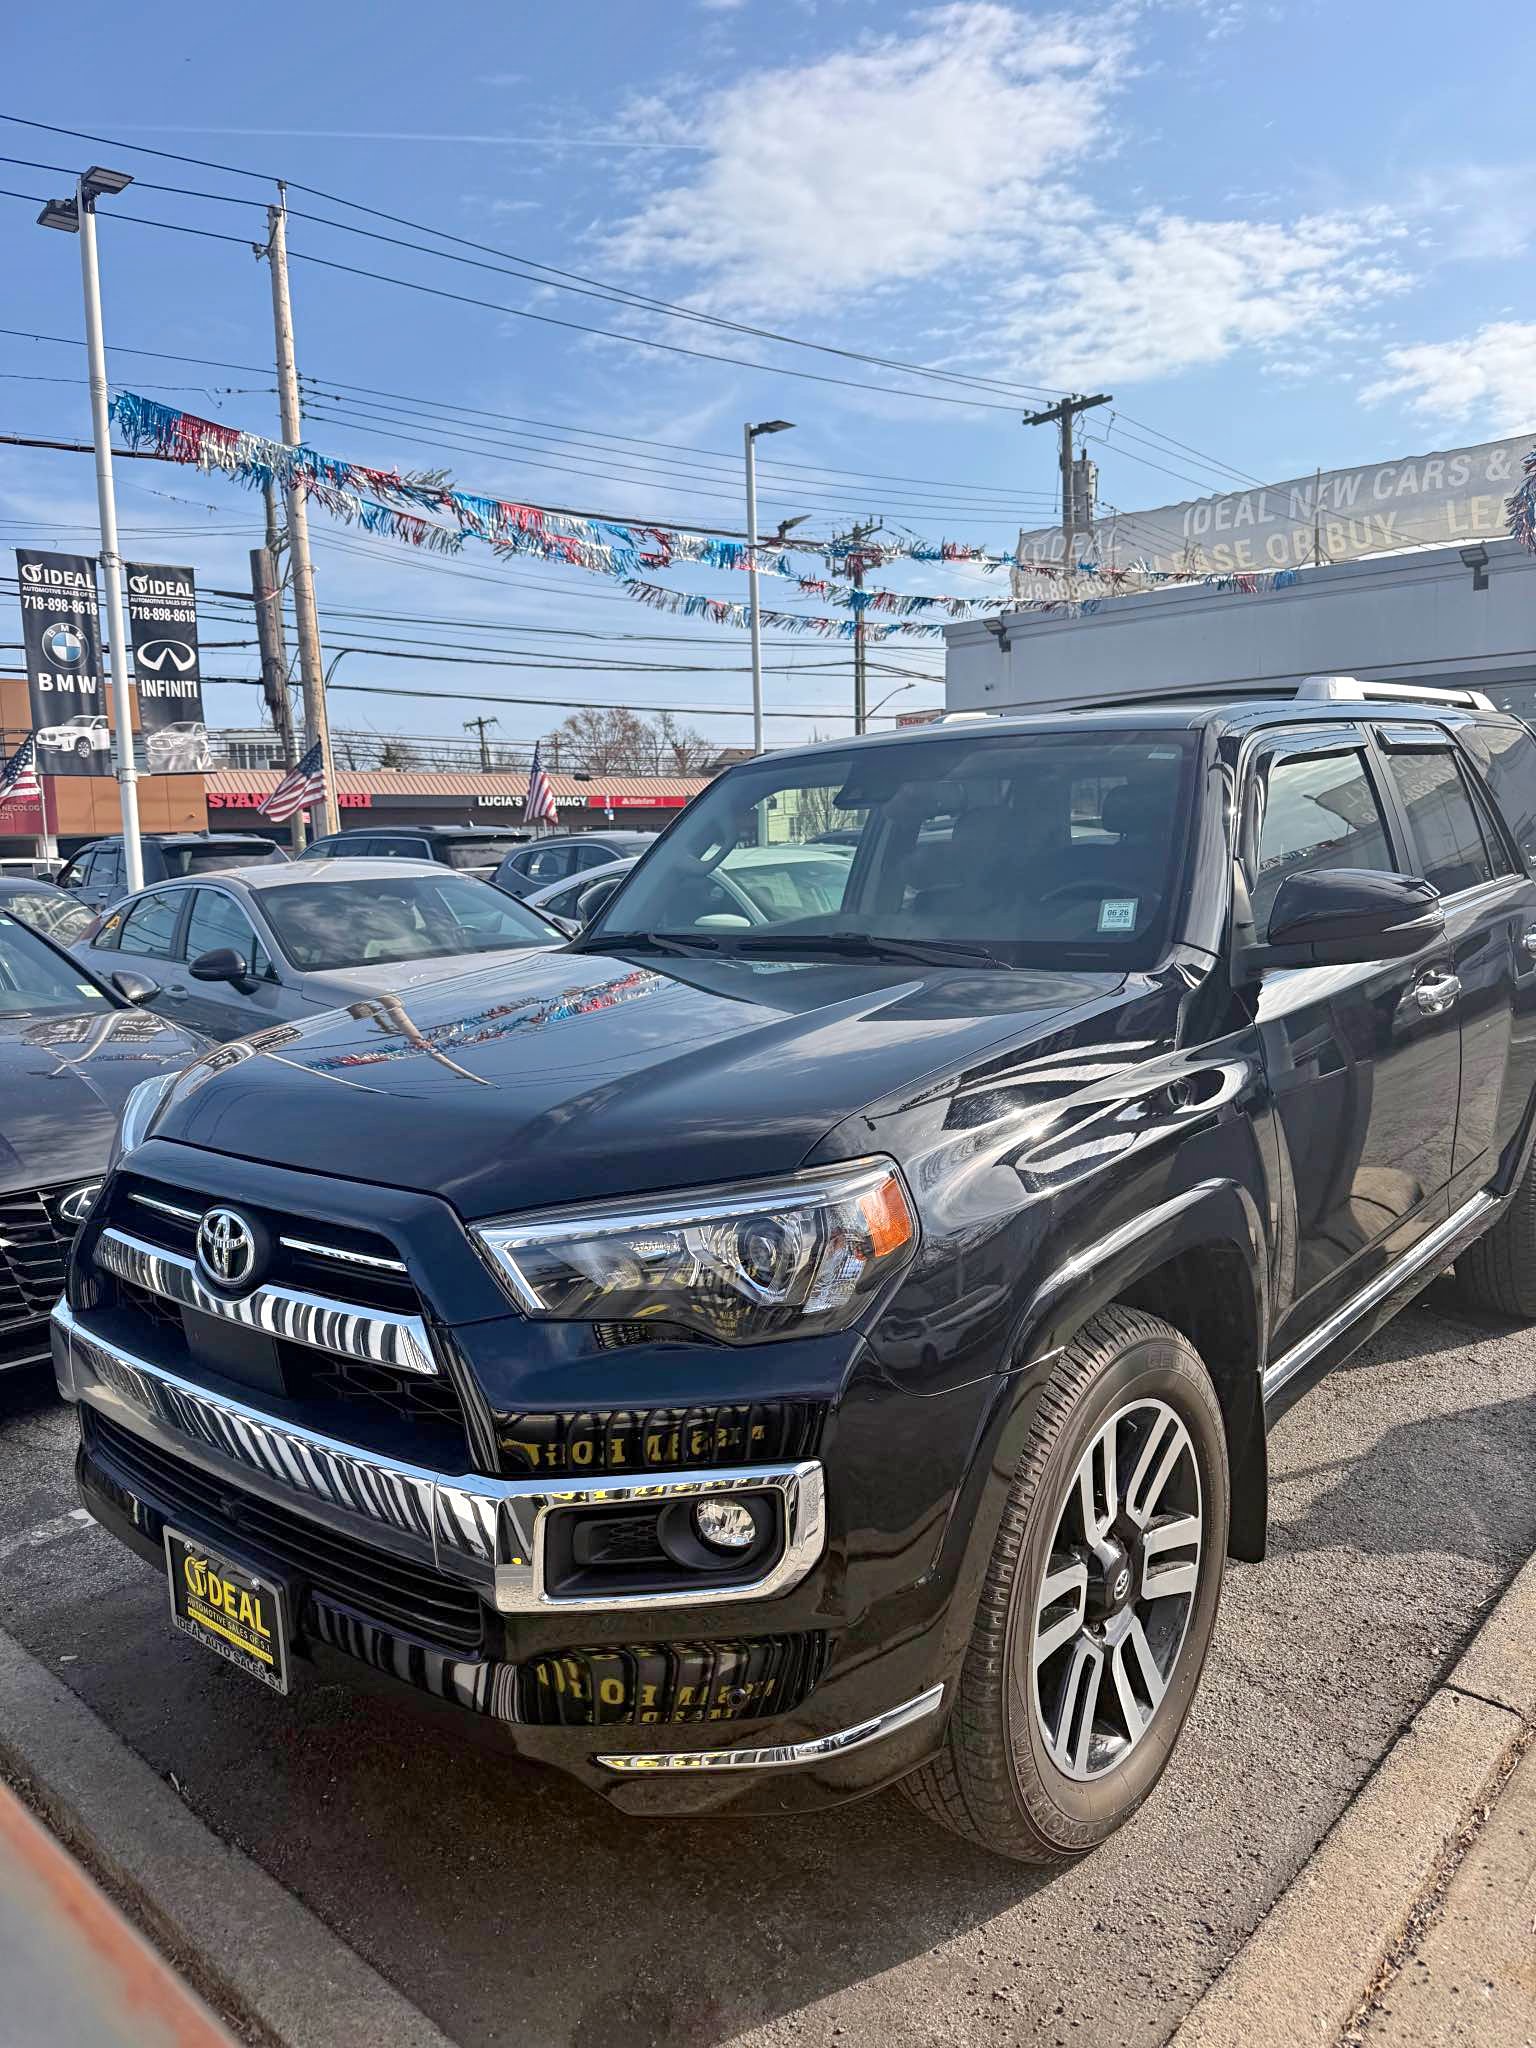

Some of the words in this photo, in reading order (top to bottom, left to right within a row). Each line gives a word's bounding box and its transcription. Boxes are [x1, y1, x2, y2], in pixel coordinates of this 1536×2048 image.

[1183, 491, 1275, 537] IDEAL
[1288, 473, 1363, 518] NEW
[1373, 454, 1471, 500] CARS
[1485, 448, 1511, 482] &
[1266, 527, 1312, 564] OR
[44, 568, 95, 589] IDEAL
[149, 579, 194, 597] IDEAL
[23, 586, 61, 594] AUTOMOTIVE
[22, 595, 98, 616] 718-898-8618
[131, 606, 196, 623] 718-898-8618
[47, 624, 84, 640] BMW
[38, 672, 97, 694] BMW
[141, 679, 198, 698] INFINITI
[208, 793, 269, 808] STAN
[478, 796, 523, 807] LUCIA'S
[184, 1556, 271, 1638] IDEAL
[187, 1597, 227, 1627] AUTOMOTIVE
[227, 1621, 248, 1640] SALES
[249, 1634, 259, 1646] OF
[175, 1614, 206, 1643] IDEAL
[206, 1634, 231, 1657] AUTO
[233, 1651, 266, 1680] SALES
